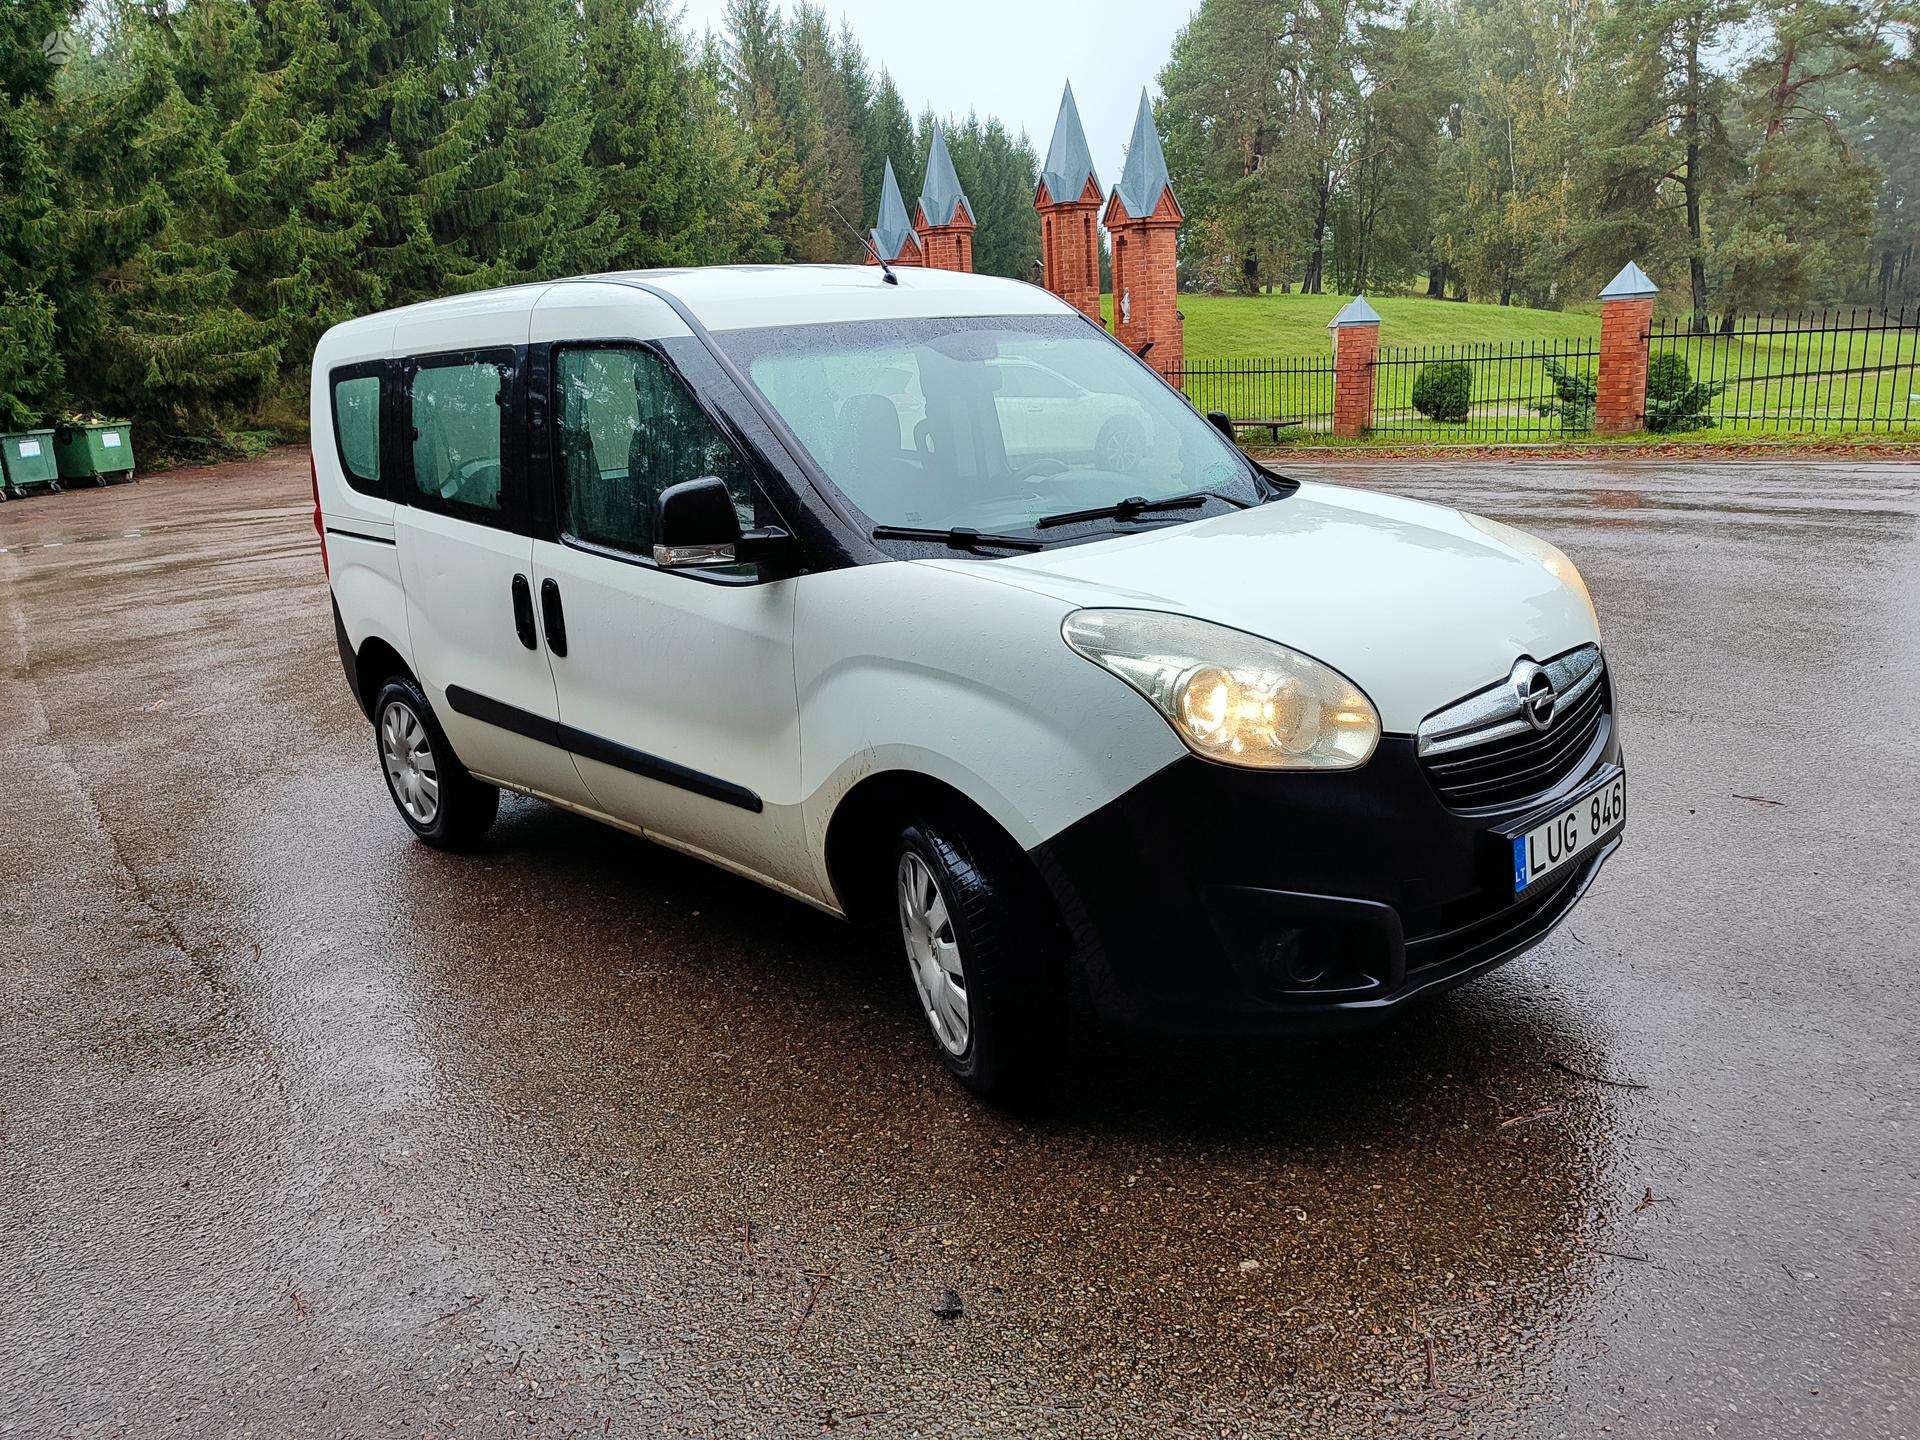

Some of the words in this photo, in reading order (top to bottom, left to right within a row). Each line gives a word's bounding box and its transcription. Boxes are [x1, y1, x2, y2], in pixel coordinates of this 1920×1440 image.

[1529, 812, 1577, 876] LUG
[1591, 782, 1621, 835] 846
[1515, 867, 1526, 882] LT
